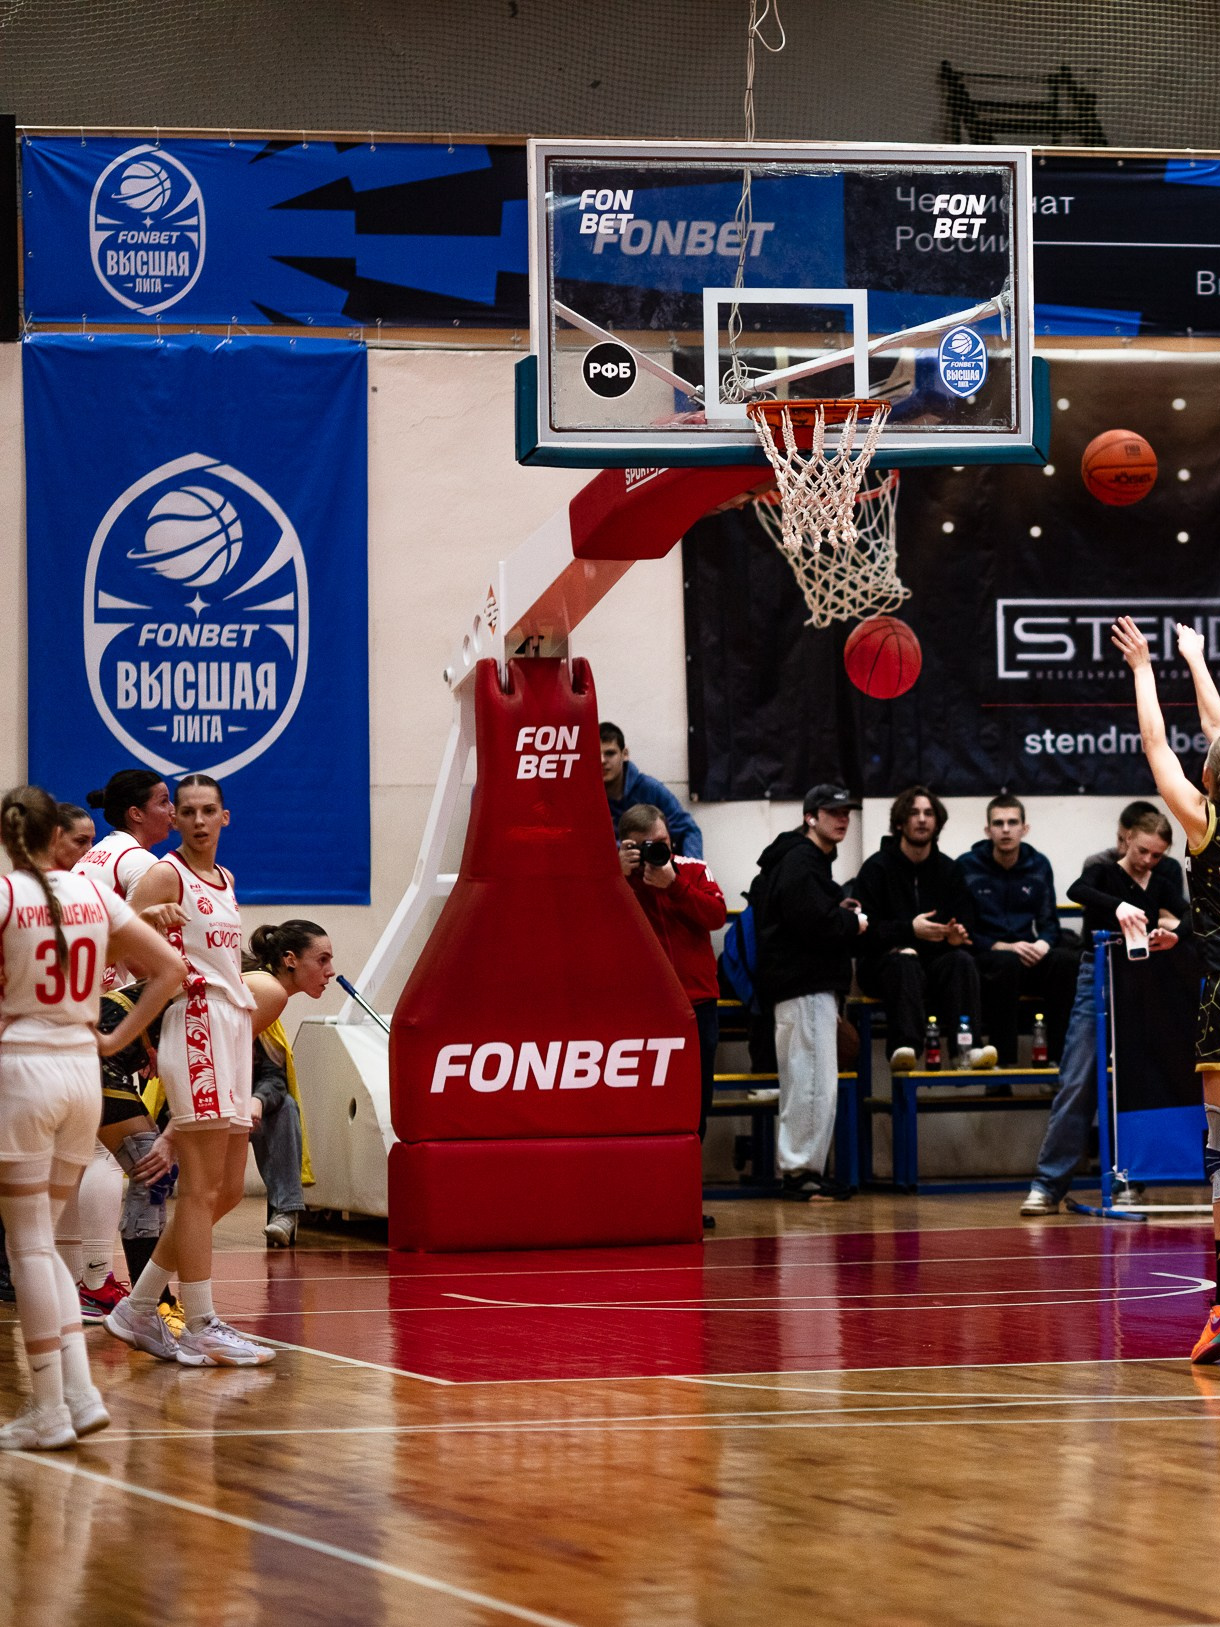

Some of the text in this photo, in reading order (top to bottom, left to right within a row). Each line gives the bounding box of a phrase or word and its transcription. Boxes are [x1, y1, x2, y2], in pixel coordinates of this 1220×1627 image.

[579, 189, 634, 210] FON
[933, 194, 986, 216] FON
[579, 213, 634, 234] BET
[933, 218, 987, 239] BET
[118, 230, 181, 245] FONBET
[592, 219, 775, 257] FONBET
[106, 249, 190, 277] ВЫСШАЯ
[134, 278, 163, 293] ЛИГА
[589, 362, 631, 379] РФБ
[946, 369, 980, 380] ВЫСШАЯ
[138, 623, 259, 648] FONBET
[116, 661, 277, 711] ВЫСШАЯ
[171, 715, 223, 743] ЛИГА
[515, 725, 580, 752] FON
[516, 754, 580, 779] BET
[16, 903, 104, 929] КРИВШЕИНА
[35, 936, 97, 1005] 30
[430, 1037, 686, 1094] FONBET
